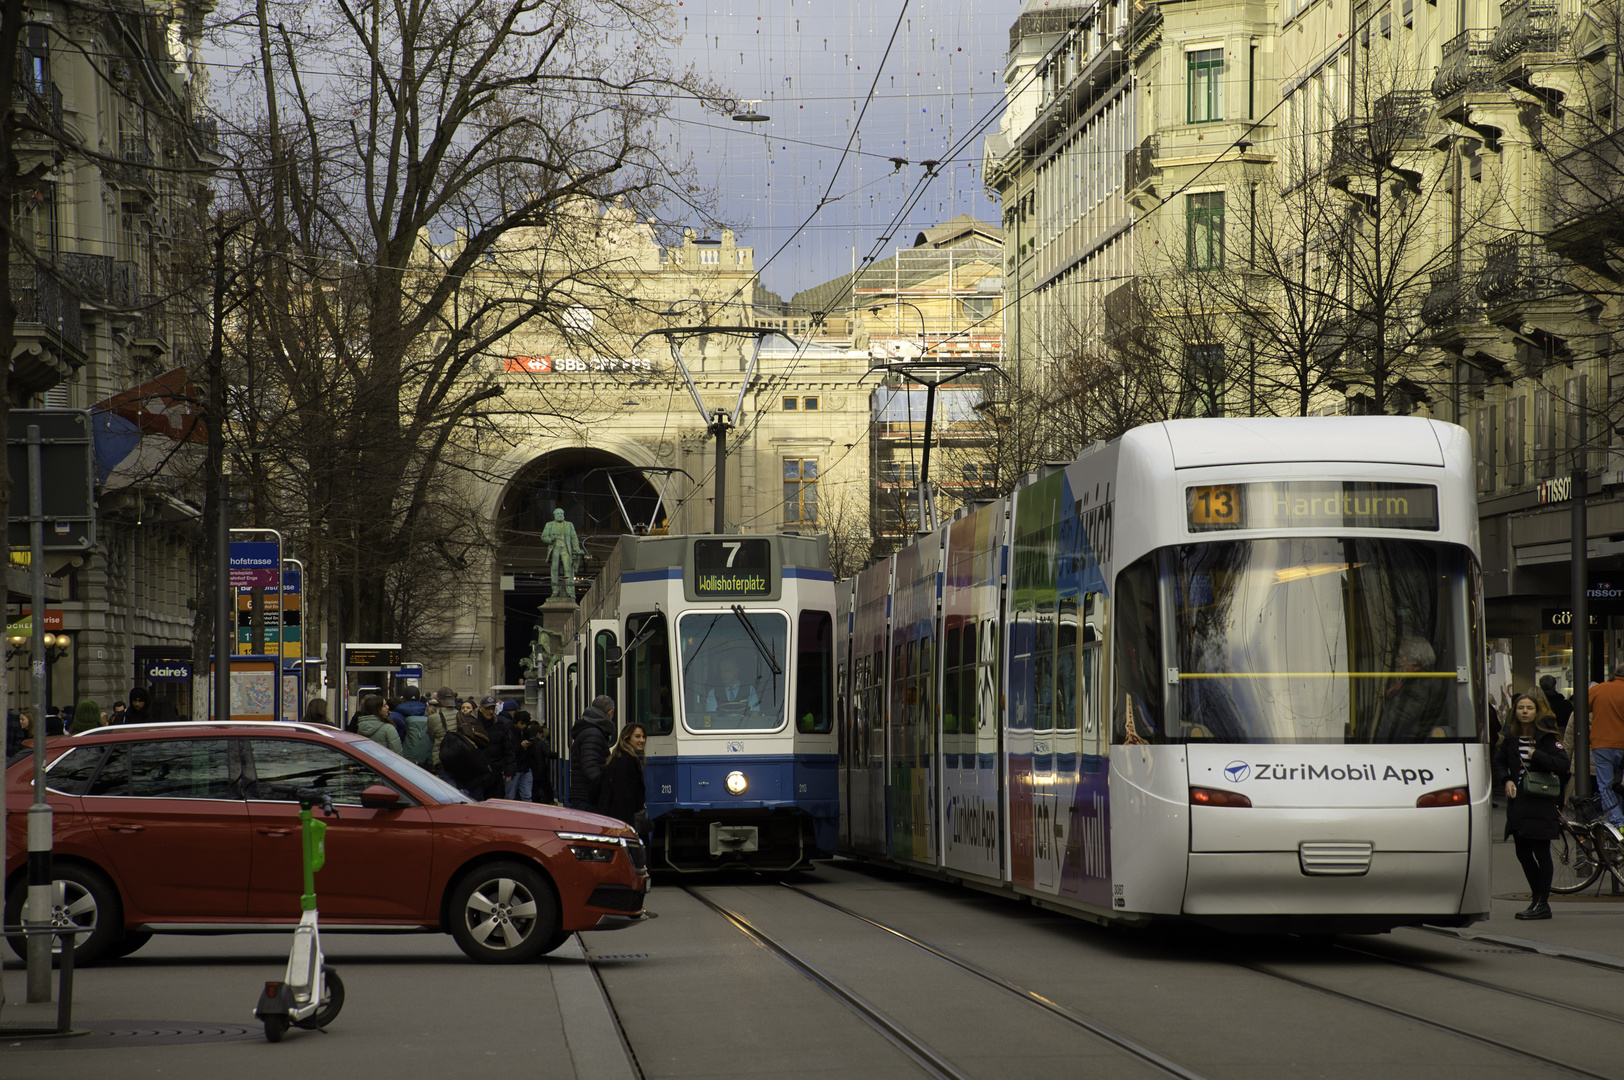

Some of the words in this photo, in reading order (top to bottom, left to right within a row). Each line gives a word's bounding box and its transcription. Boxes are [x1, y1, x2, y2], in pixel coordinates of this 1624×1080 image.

[555, 358, 587, 371] SBB
[1198, 491, 1233, 518] 13
[1273, 490, 1409, 516] Hardturm
[722, 542, 741, 567] 7
[699, 574, 766, 594] Wollishoferplatz
[150, 666, 188, 677] claire's
[1254, 763, 1377, 781] ZüriMobil
[1382, 765, 1434, 785] App
[661, 784, 672, 794] 2113
[981, 799, 996, 862] App
[1082, 790, 1107, 879] will
